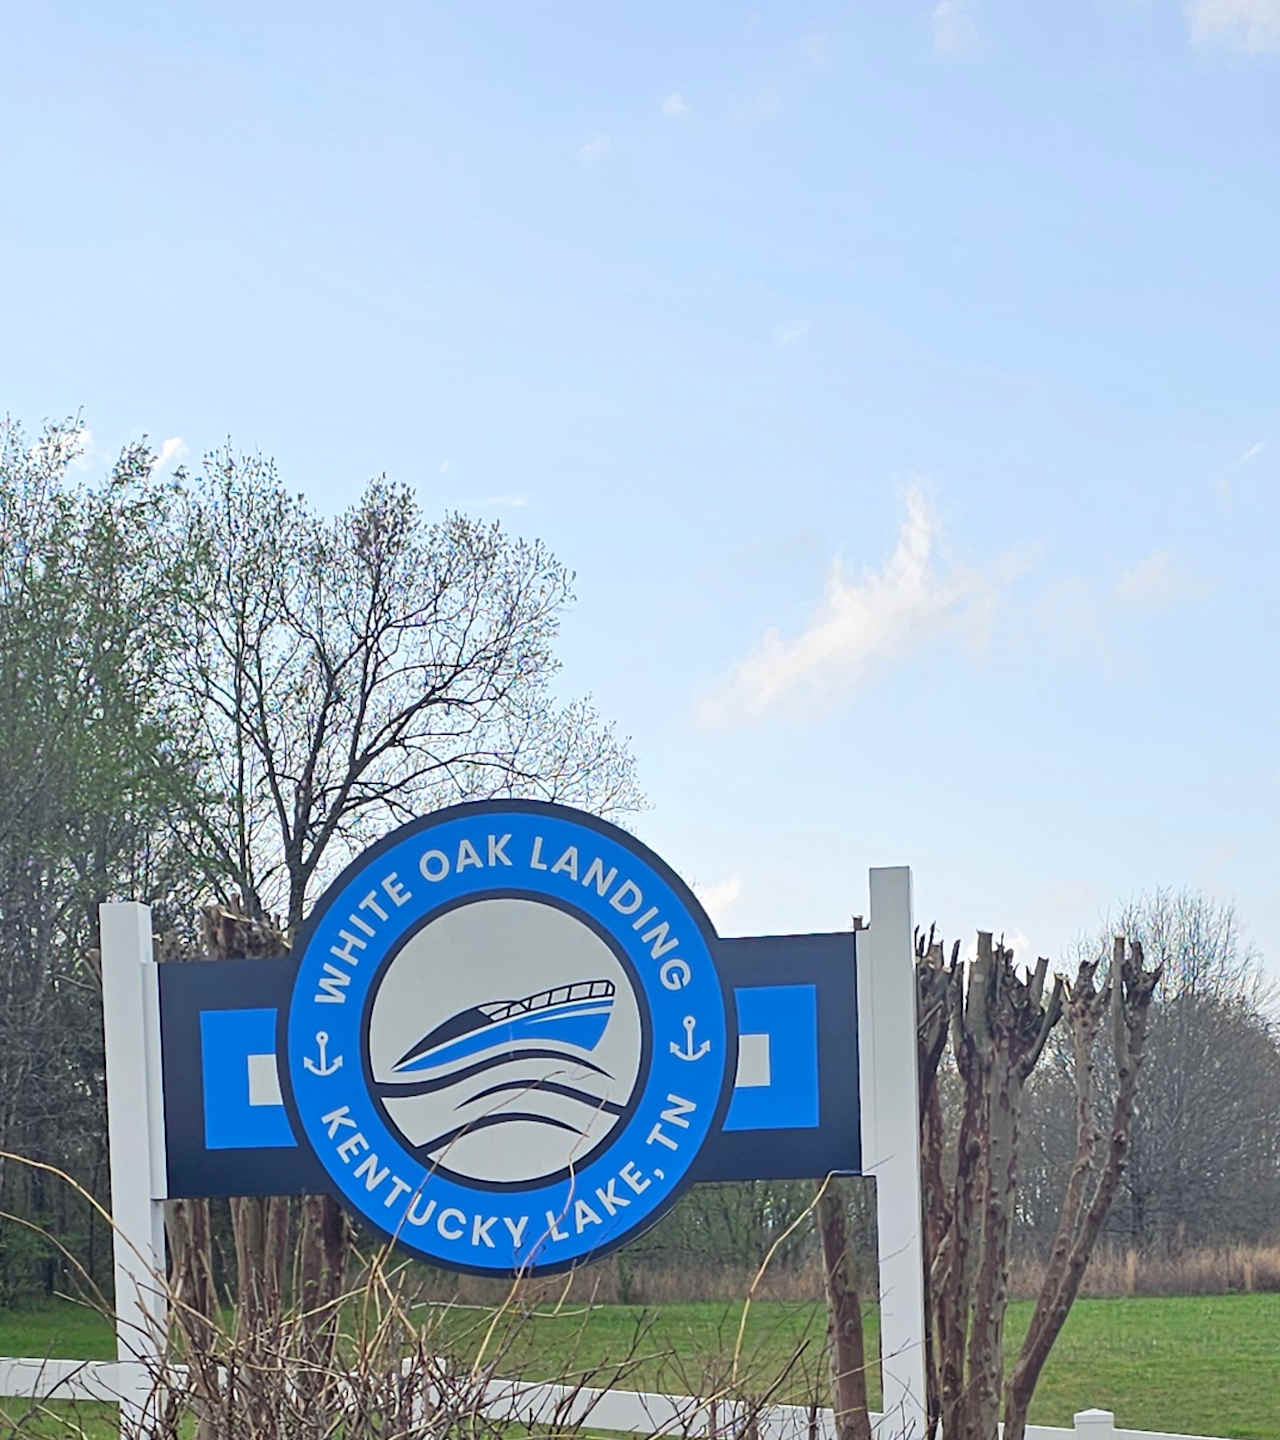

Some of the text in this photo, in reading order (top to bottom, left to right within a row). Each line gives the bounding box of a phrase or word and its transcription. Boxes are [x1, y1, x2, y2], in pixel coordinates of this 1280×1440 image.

[314, 834, 692, 1003] WHITE OAK LANDING
[321, 1093, 697, 1249] KENTUCKY LAKE, TN
